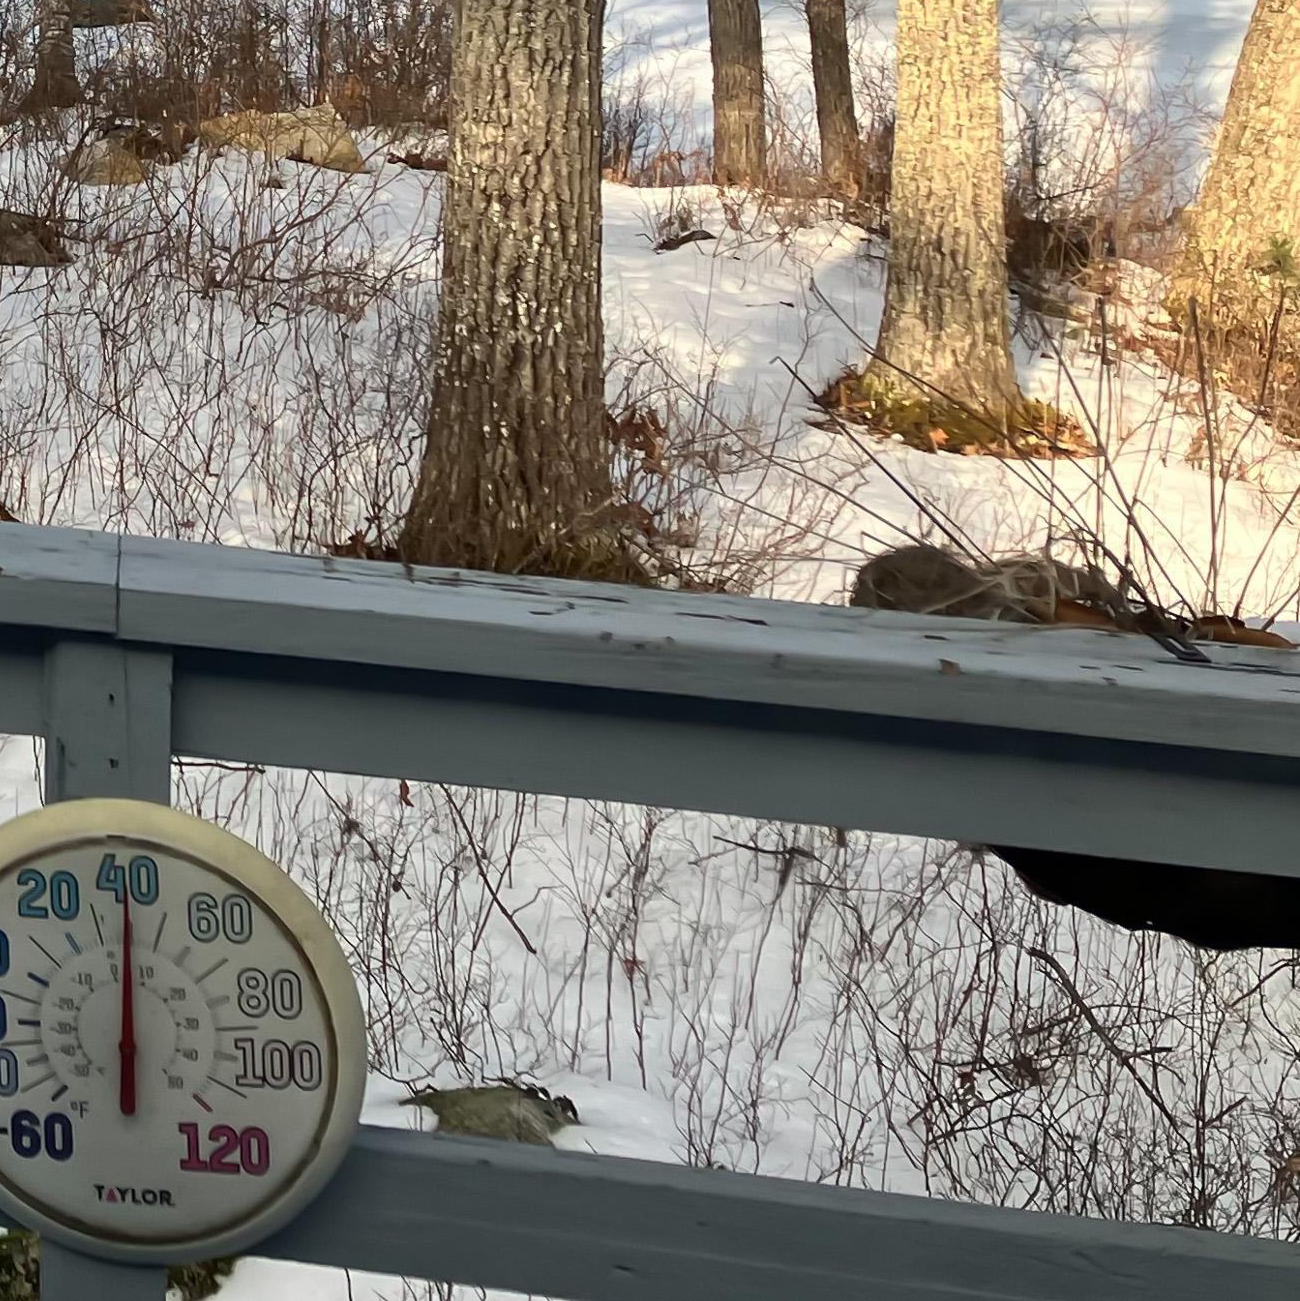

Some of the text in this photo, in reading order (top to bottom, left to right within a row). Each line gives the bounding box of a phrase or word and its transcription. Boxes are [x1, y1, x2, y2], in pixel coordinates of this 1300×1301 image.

[17, 868, 80, 921] 20
[96, 853, 159, 905] 40
[187, 893, 252, 945] 60
[237, 968, 302, 1020] 80
[234, 1038, 322, 1092] 100
[178, 1122, 270, 1175] 120
[93, 1183, 175, 1208] TAYLOR
